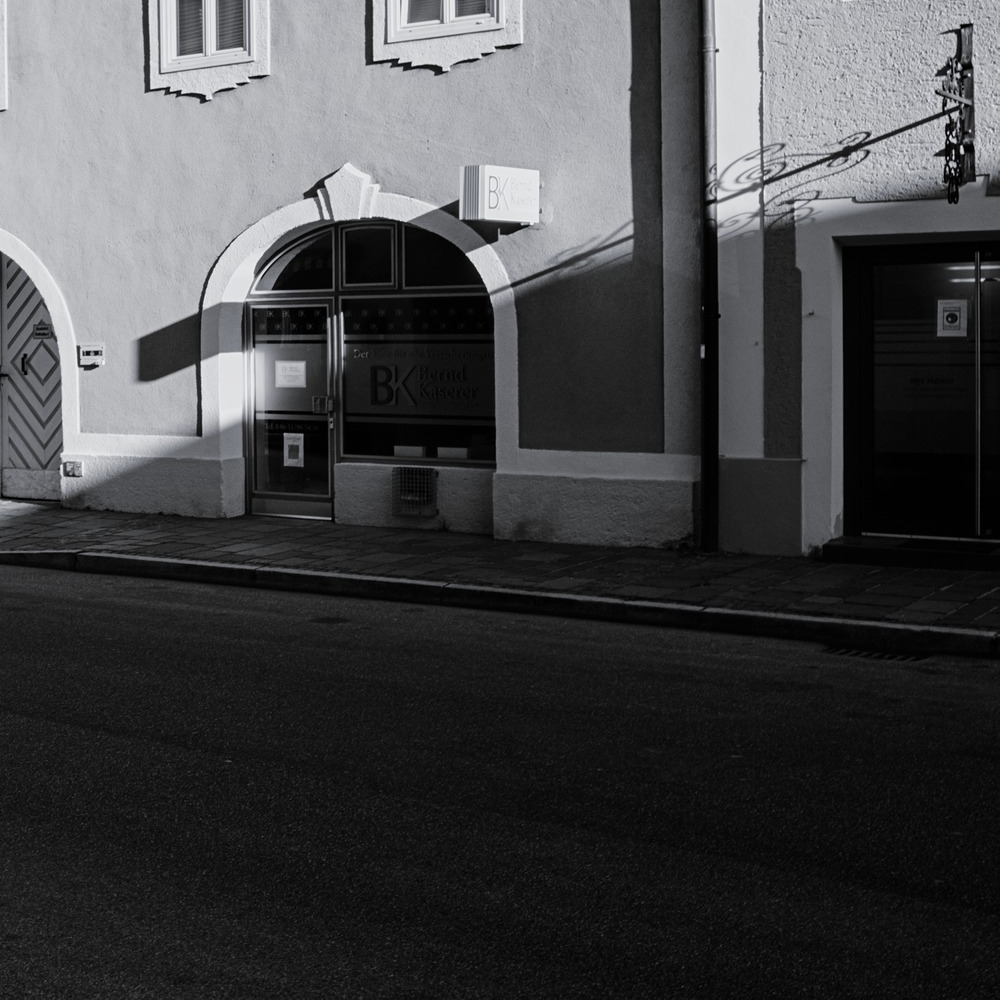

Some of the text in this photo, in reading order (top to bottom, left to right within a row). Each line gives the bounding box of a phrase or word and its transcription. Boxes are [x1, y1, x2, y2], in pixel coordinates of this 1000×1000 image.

[488, 175, 510, 211] BK
[353, 348, 369, 358] Der
[370, 365, 418, 406] BK
[417, 364, 466, 382] Bernd
